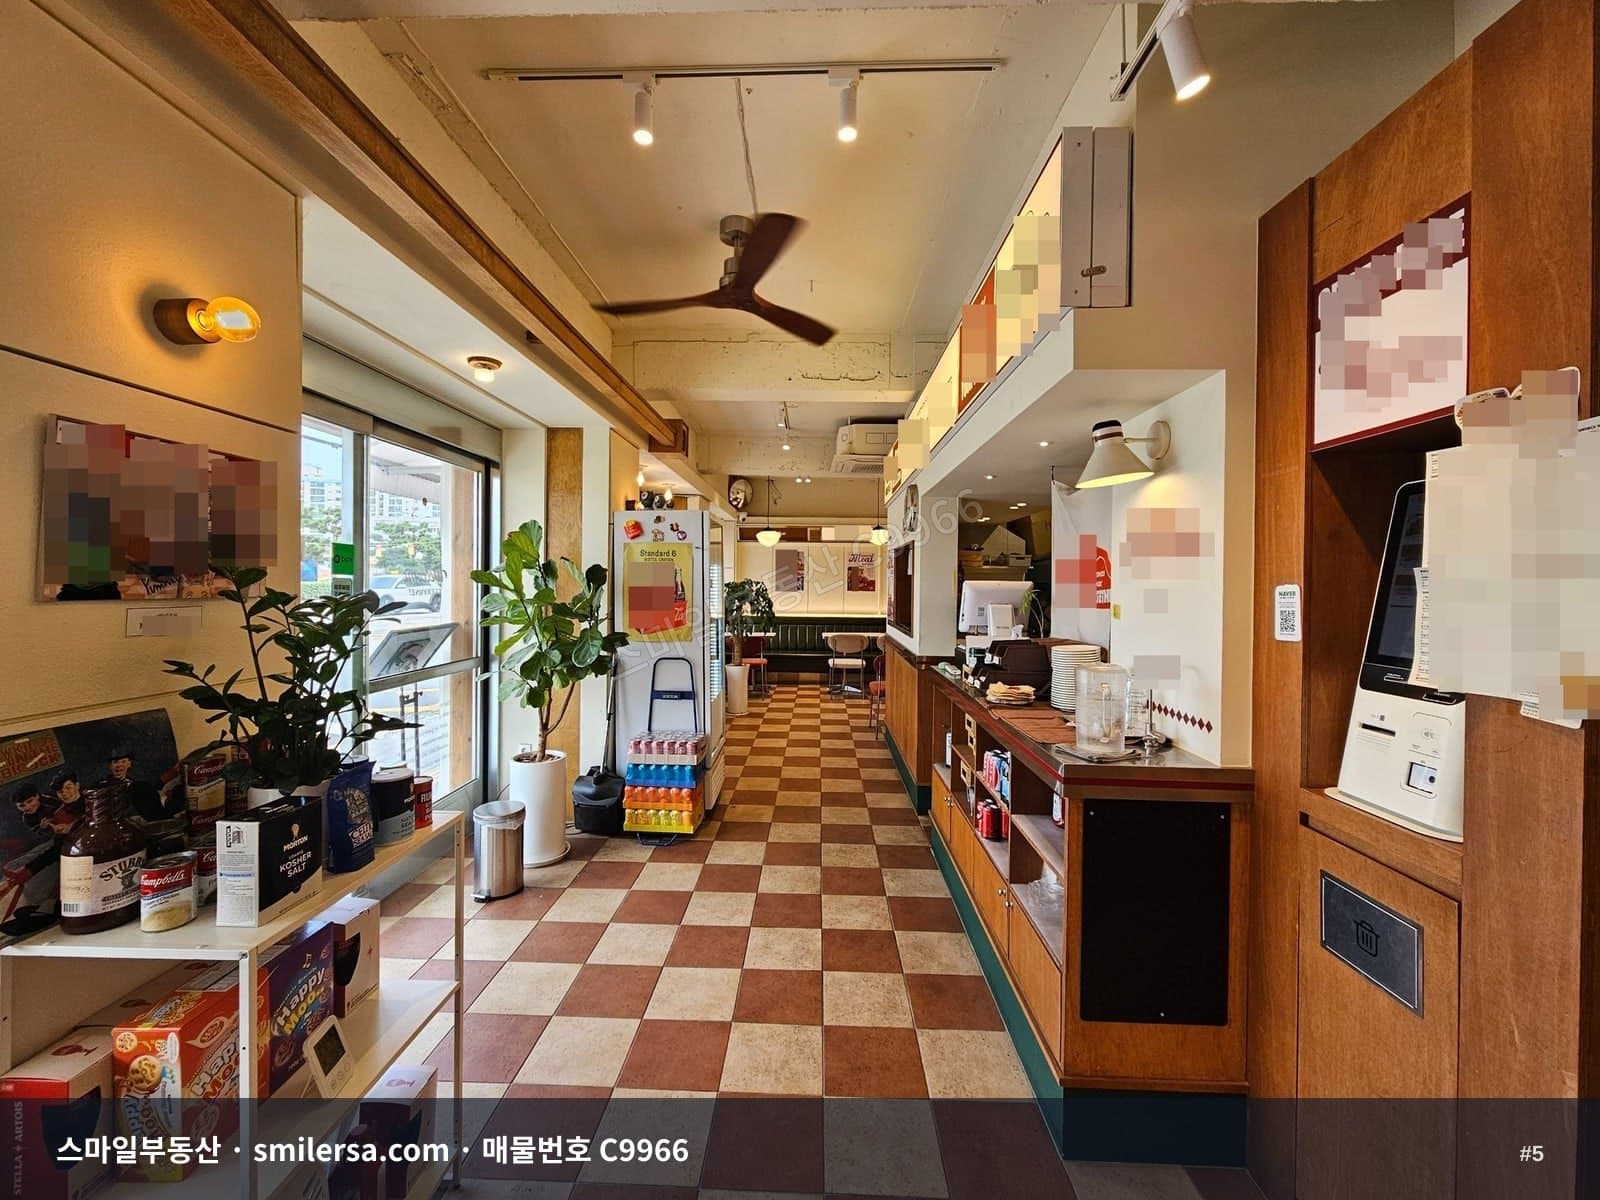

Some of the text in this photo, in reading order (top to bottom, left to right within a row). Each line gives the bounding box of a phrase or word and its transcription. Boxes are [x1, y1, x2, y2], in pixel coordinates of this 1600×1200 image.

[639, 549, 670, 557] Standard
[283, 835, 309, 852] MORTON
[280, 851, 312, 873] KOSHER
[287, 862, 307, 878] SALT
[276, 967, 325, 1027] Happy
[15, 1100, 23, 1142] ARTOIS
